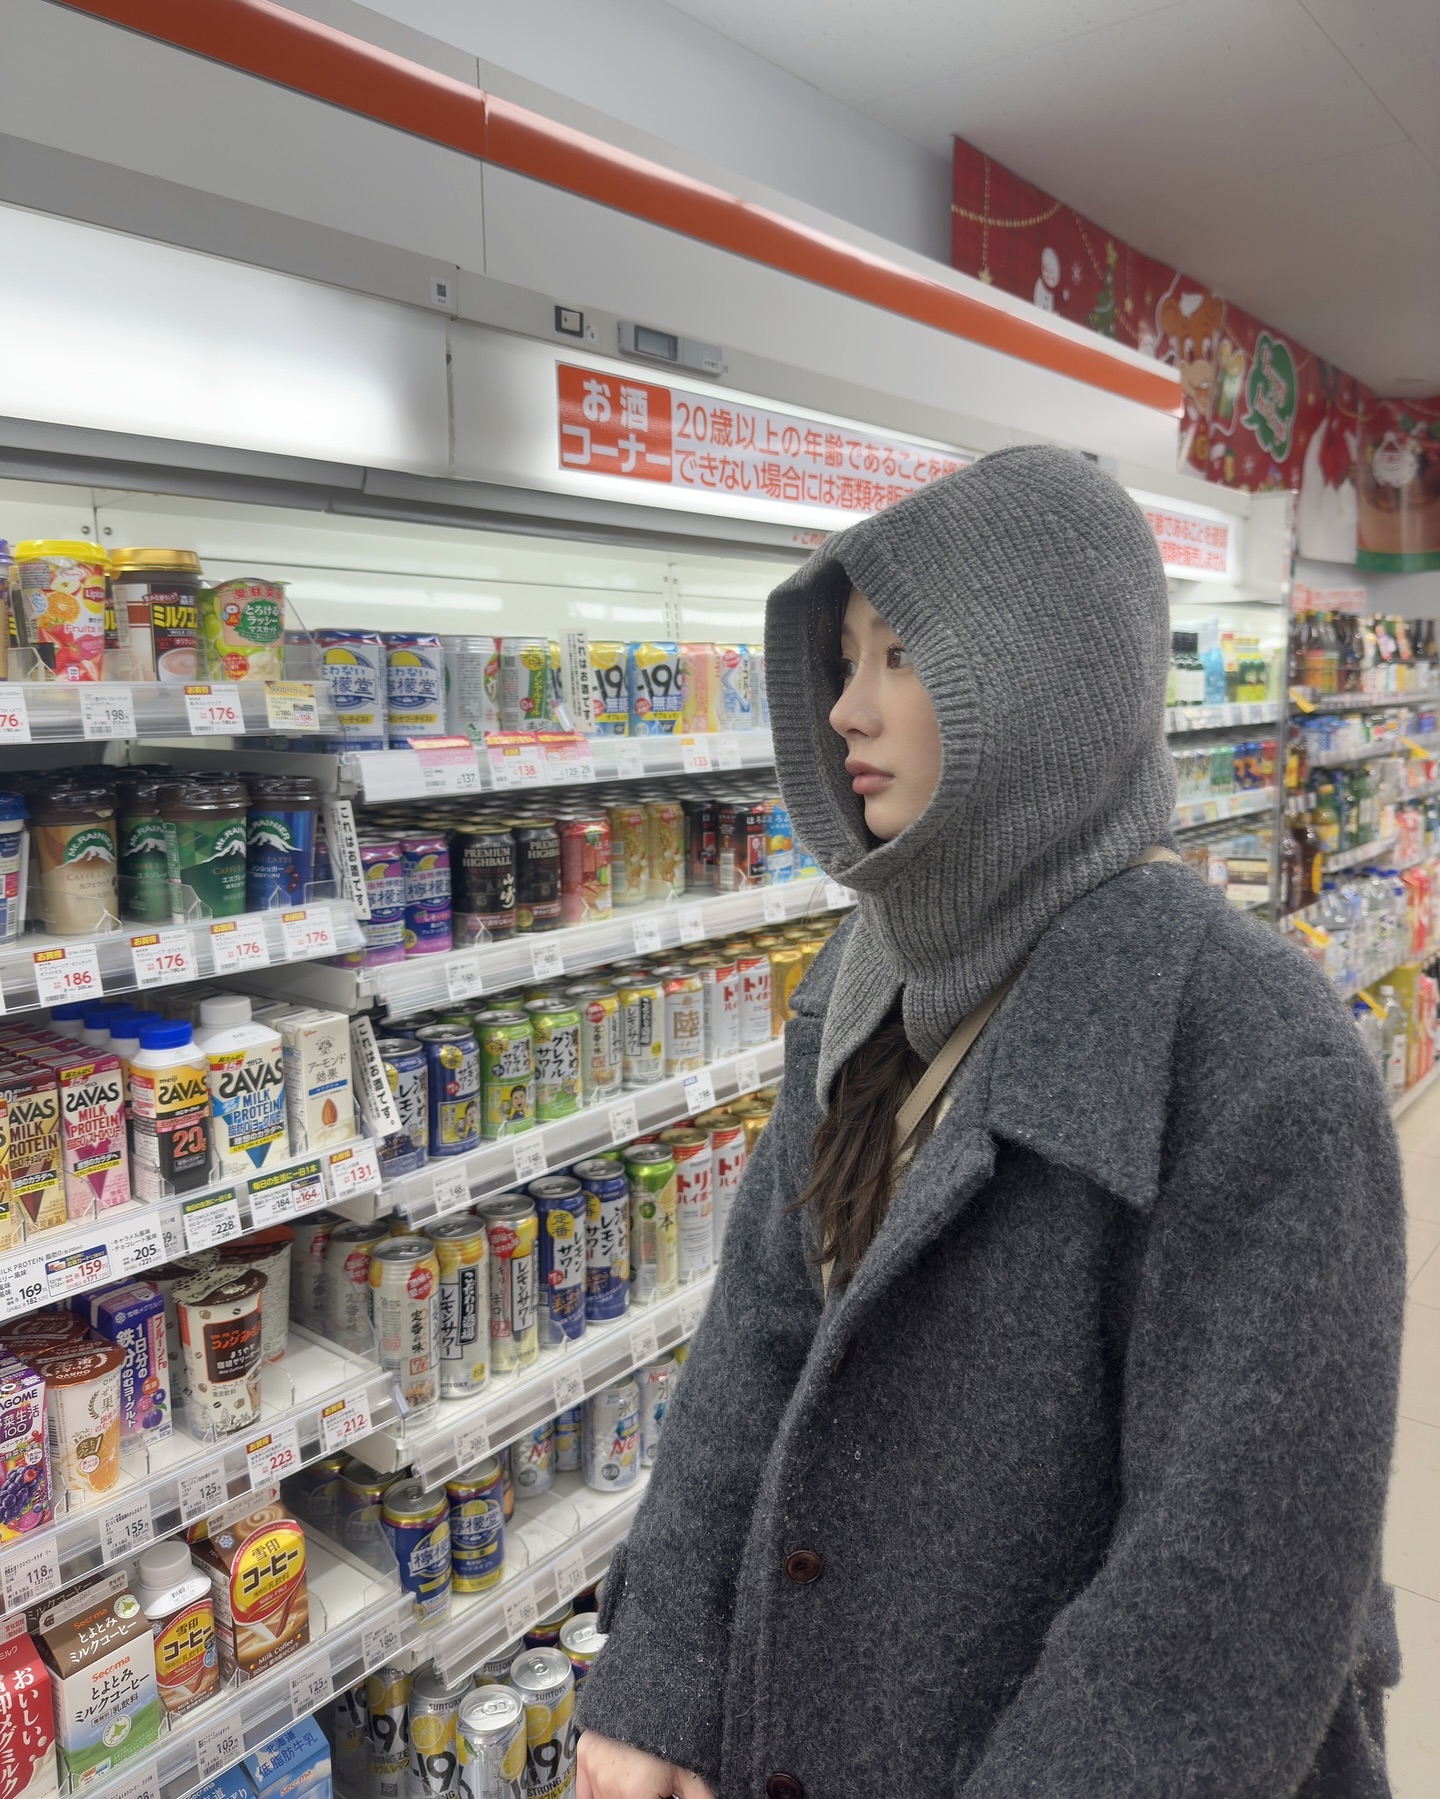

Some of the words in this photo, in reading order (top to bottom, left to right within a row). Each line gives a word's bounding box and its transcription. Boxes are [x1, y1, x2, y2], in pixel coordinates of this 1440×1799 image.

[582, 378, 650, 431] お酒
[561, 424, 672, 474] コーナー
[245, 604, 280, 616] とろける
[247, 615, 279, 626] ラッシー
[66, 623, 96, 634] Fruits
[105, 709, 126, 721] 198
[209, 708, 235, 720] 176
[462, 858, 513, 868] HIGHBALL
[463, 846, 511, 859] PREMIUM
[236, 942, 260, 956] 176
[306, 931, 328, 944] 176
[156, 954, 184, 970] 176
[64, 971, 92, 987] 186
[246, 1057, 264, 1067] ザバス
[308, 1052, 347, 1073] アーモンド
[536, 1047, 551, 1079] サワー
[551, 1035, 565, 1079] グレフル
[159, 1075, 178, 1084] meiji
[219, 1057, 283, 1099] SAVAS
[316, 1067, 339, 1083] 効果
[66, 1082, 120, 1113] SAVAS
[242, 1089, 270, 1108] MILK
[398, 1084, 415, 1126] レモン
[8, 1098, 56, 1126] AVAS
[79, 1104, 107, 1125] MILK
[233, 1098, 281, 1124] PROTEIN
[70, 1113, 120, 1139] PROTEIN
[252, 1164, 318, 1195] 毎日の生活に一日1本
[350, 1164, 373, 1181] 131
[276, 1197, 291, 1209] 184
[299, 1189, 318, 1202] 164
[216, 1220, 236, 1234] 228
[552, 1212, 569, 1238] 定番
[601, 1215, 614, 1256] レモン
[134, 1243, 157, 1262] 205
[587, 1226, 600, 1259] サワー
[14, 1256, 44, 1271] PROTEIN
[557, 1244, 573, 1280] サワー
[462, 1270, 477, 1341] こだわり酒場
[517, 1261, 532, 1327] レモンサワー
[410, 1309, 425, 1355] 定番の味
[441, 1288, 458, 1357] レモンサワー
[135, 1323, 148, 1379] 1日分の
[0, 1404, 39, 1429] 菜生活
[344, 1414, 366, 1434] 212
[4, 1423, 27, 1439] 100
[270, 1450, 294, 1471] 223
[252, 1537, 281, 1562] 雪印
[242, 1548, 299, 1595] コーヒー
[73, 1607, 109, 1631] Secoma
[78, 1616, 118, 1644] とよとみ
[175, 1616, 199, 1637] 雪印
[69, 1621, 137, 1664] ミルクコーヒー
[163, 1624, 212, 1662] コーヒー
[257, 1651, 274, 1666] Milk
[274, 1639, 295, 1656] Coffee
[379, 1632, 395, 1649] 180
[91, 1655, 131, 1682] Secoma
[90, 1668, 134, 1701] とよとみ
[534, 1685, 568, 1702] SUNTORY
[12, 1666, 42, 1747] おいしい
[74, 1673, 151, 1724] ミルクコーヒー
[112, 1692, 140, 1717] 乳飲料
[258, 1730, 319, 1779] 低脂肪牛乳
[266, 1731, 298, 1756] 北海道
[279, 1768, 313, 1797] Secoma
